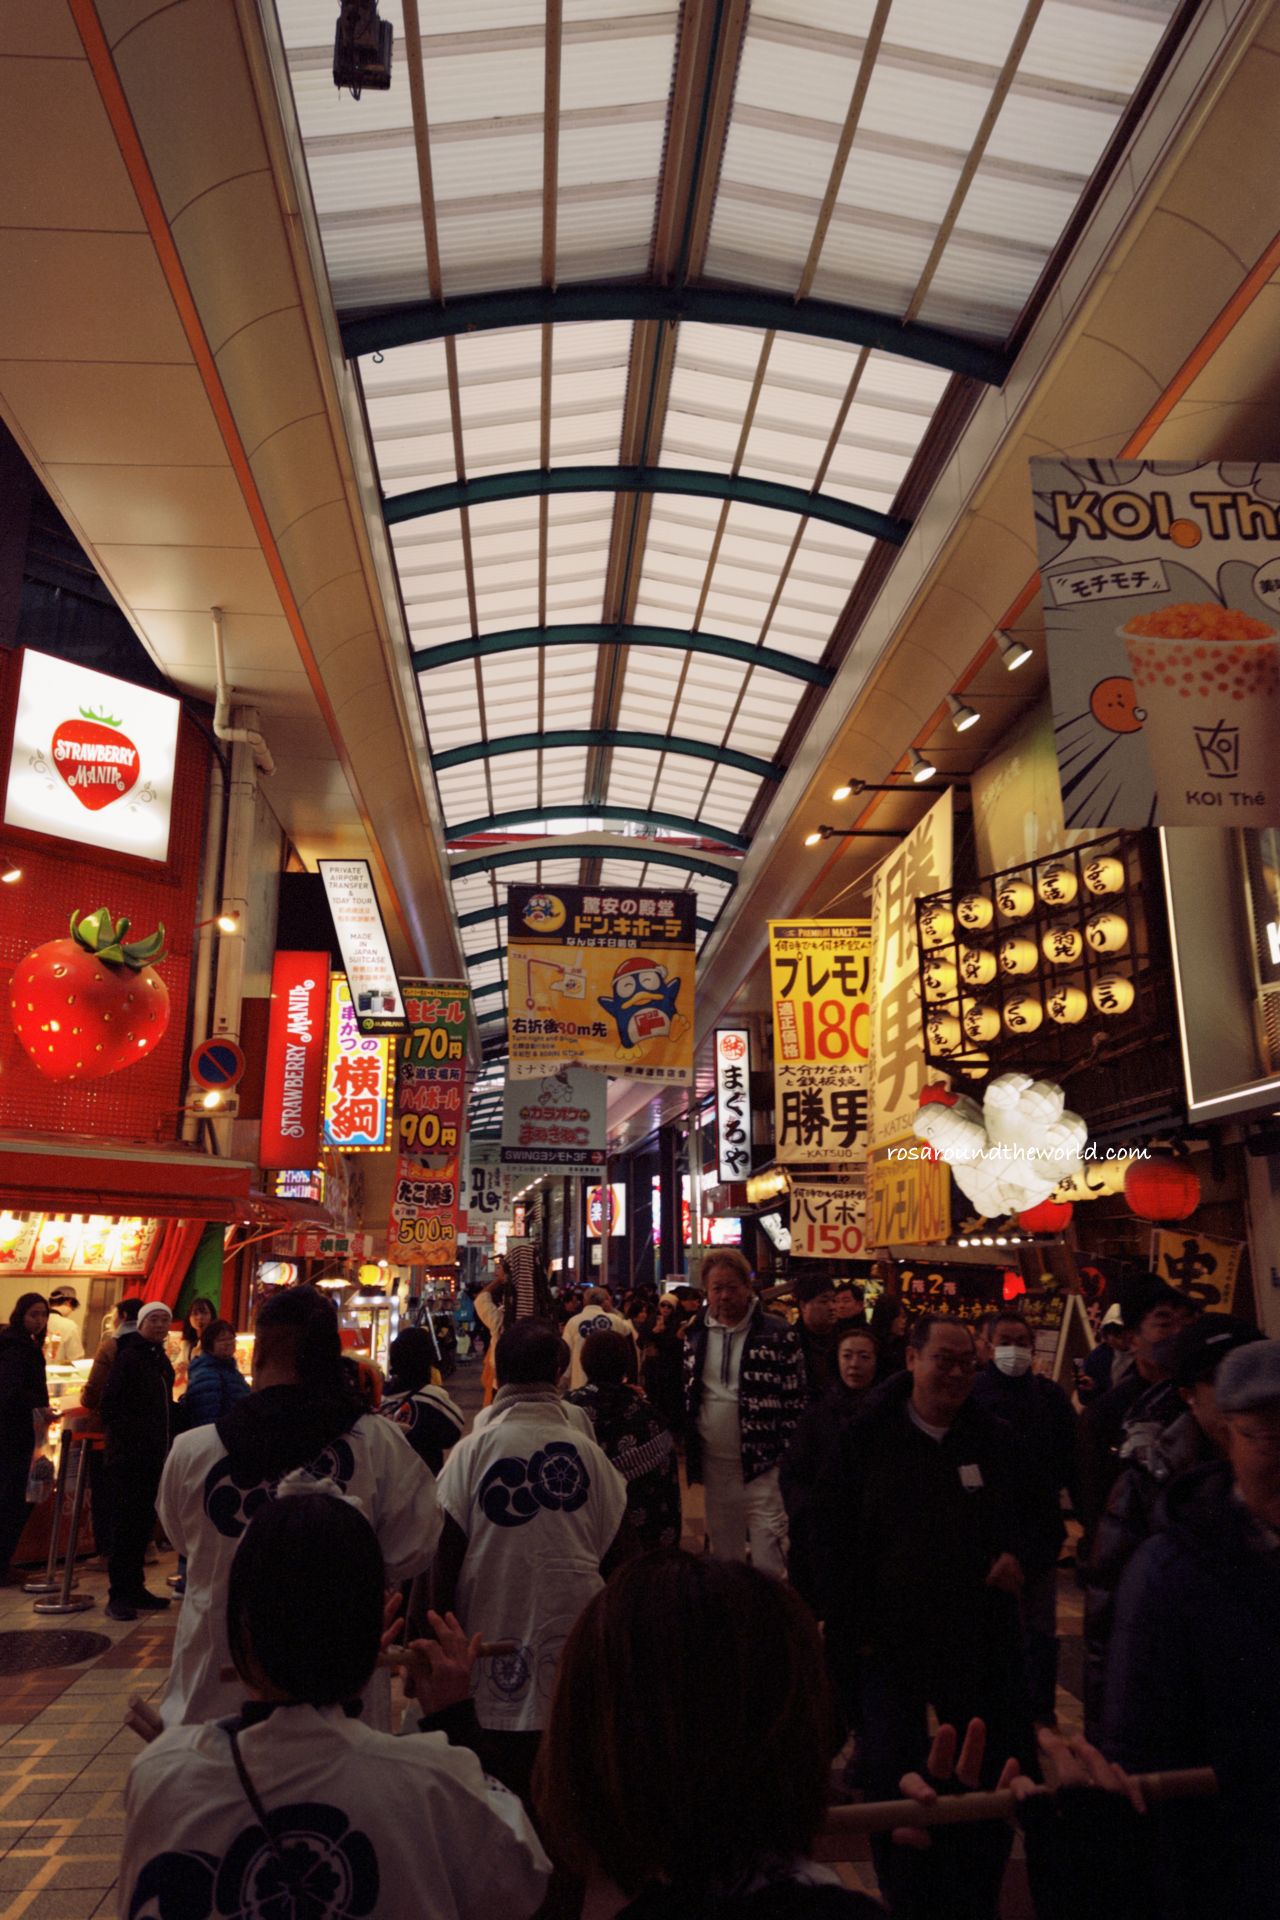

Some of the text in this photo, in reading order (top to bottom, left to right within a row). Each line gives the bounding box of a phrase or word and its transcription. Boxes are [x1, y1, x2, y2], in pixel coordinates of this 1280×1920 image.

[1051, 491, 1280, 540] KOI Th
[54, 739, 136, 767] STRAWBERRY
[68, 765, 126, 791] MANIA
[1186, 790, 1265, 806] KOI Thé
[330, 867, 361, 875] PRIVATE
[287, 980, 315, 1043] MANIA
[280, 1042, 305, 1138] STRAWBERRY
[332, 1055, 381, 1139] 横綱
[398, 1216, 454, 1243] 500円
[808, 1225, 862, 1254] 150
